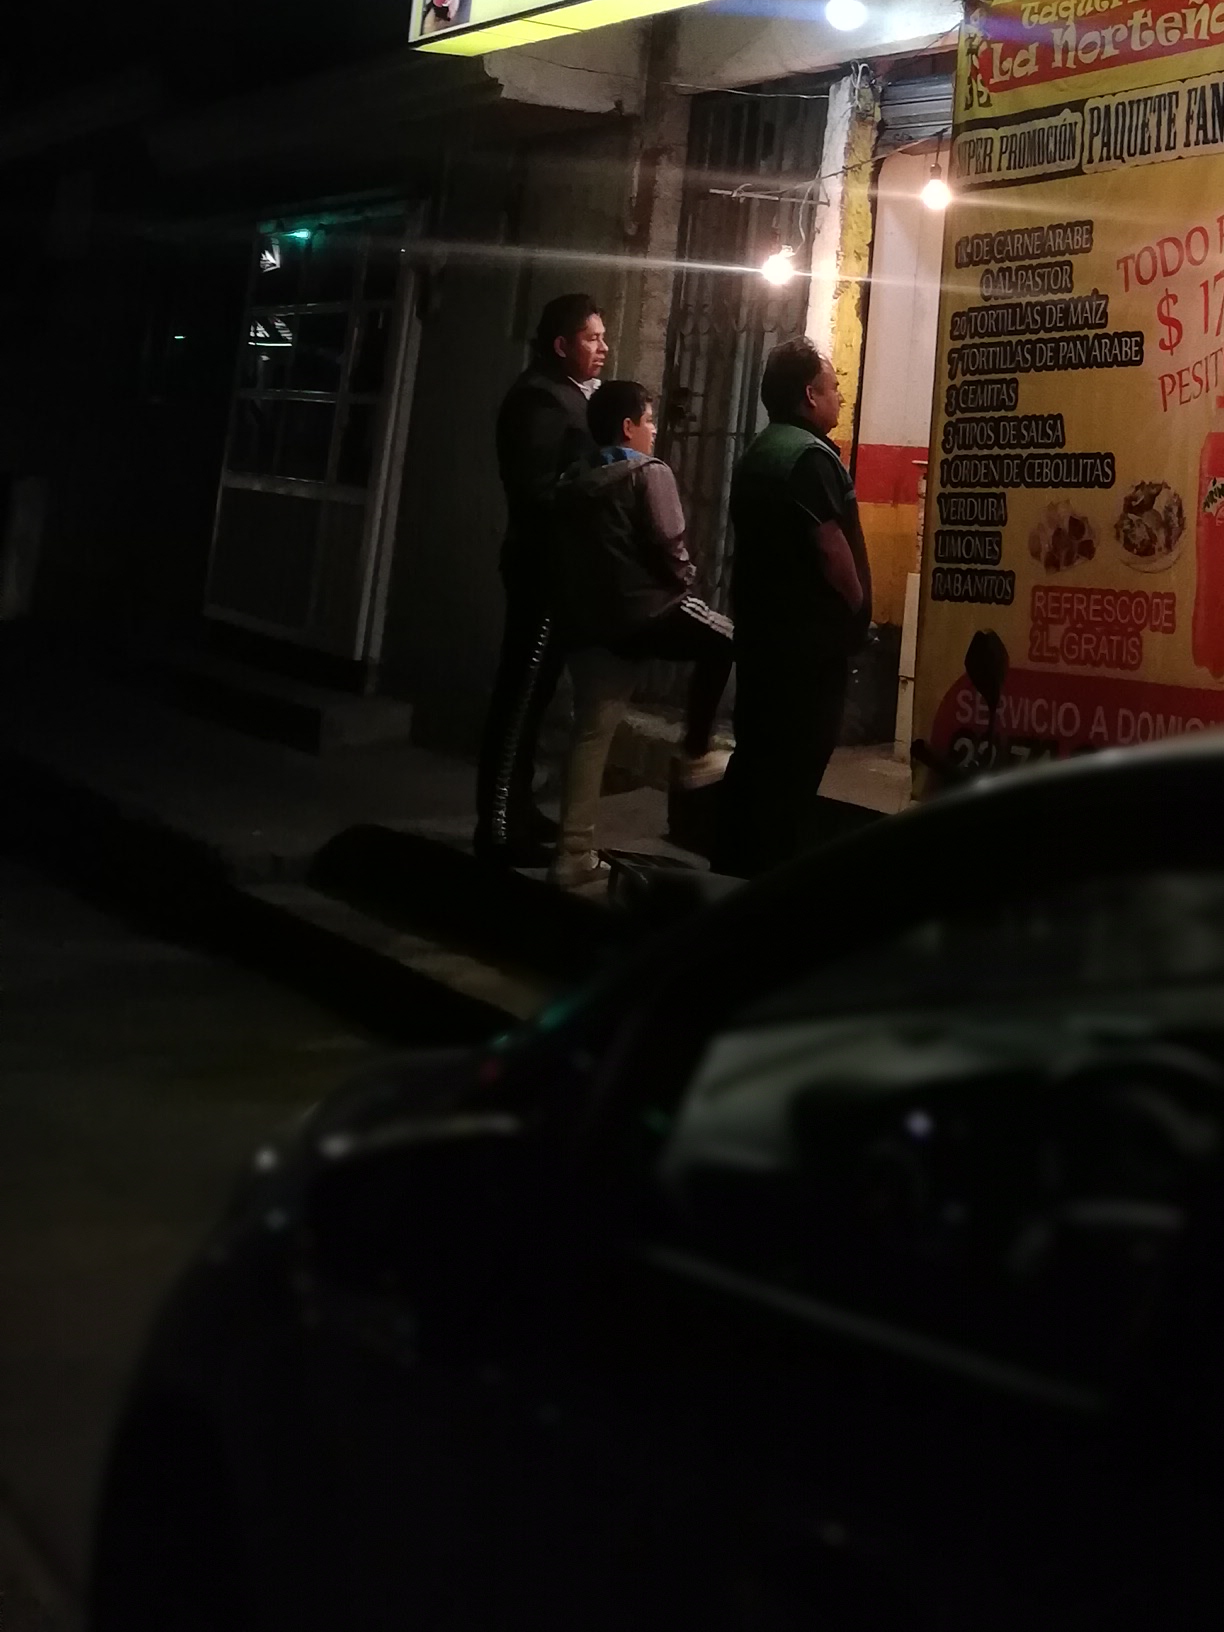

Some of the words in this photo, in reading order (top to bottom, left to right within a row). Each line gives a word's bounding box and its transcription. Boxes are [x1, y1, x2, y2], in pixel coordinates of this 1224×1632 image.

[989, 41, 1040, 85] La
[1086, 90, 1180, 165] PAQUETE
[955, 136, 994, 180] UPER
[997, 116, 1079, 172] PROMOCIÓN
[973, 238, 991, 262] DE
[993, 231, 1042, 259] CARNE
[1045, 225, 1092, 253] ARABE
[1116, 226, 1210, 293] TODO
[982, 273, 993, 297] O
[997, 271, 1014, 295] AL
[1017, 265, 1073, 294] PASTOR
[952, 315, 968, 336] 20
[969, 306, 1042, 335] TORTILLAS
[1045, 303, 1065, 329] DE
[1156, 287, 1185, 357] $
[951, 353, 959, 374] 7
[961, 343, 1033, 372] TORTILLAS
[1035, 342, 1056, 367] DE
[1058, 340, 1088, 365] PAN
[1090, 336, 1142, 364] ARABE
[949, 389, 957, 412] 3
[959, 382, 1017, 409] CEMITAS
[945, 426, 954, 449] 3
[957, 421, 995, 446] TIPOS
[999, 420, 1018, 445] DE
[1020, 419, 1064, 445] SALSA
[951, 459, 1000, 484] ORDEN
[1003, 459, 1022, 483] DE
[1024, 458, 1113, 484] CEBOLLITAS
[941, 497, 1006, 522] VERDURA
[937, 535, 1001, 560] LIMONES
[934, 572, 1013, 600] RABANITOS
[1034, 590, 1148, 625] REFRESCO
[1151, 597, 1174, 628] DE
[1063, 632, 1141, 665] GRATIS
[954, 689, 1082, 738] SERVICIO
[1088, 704, 1110, 742] A
